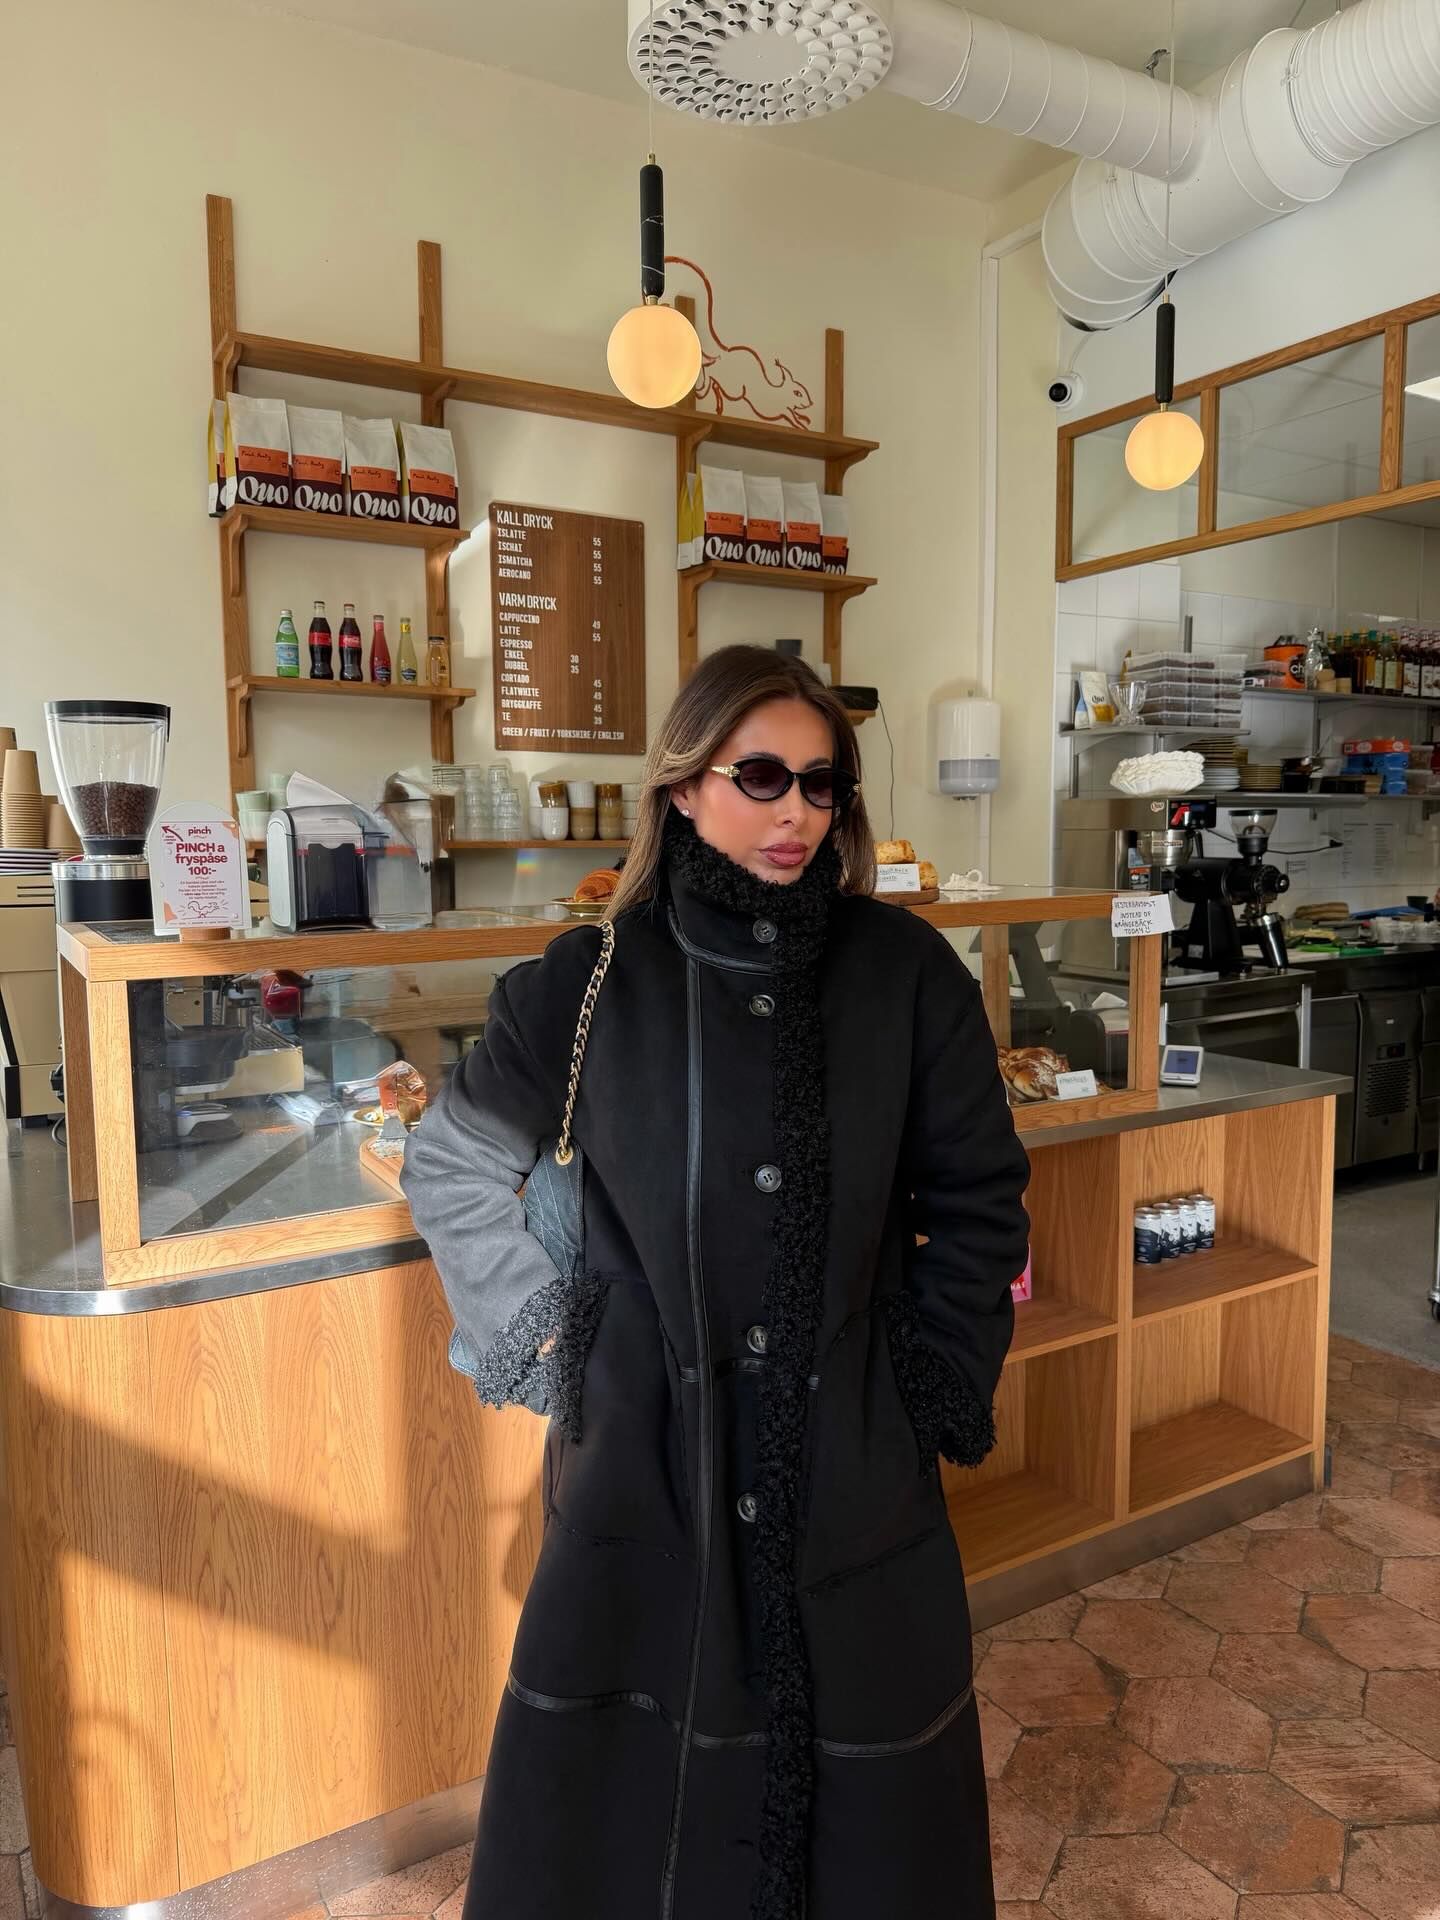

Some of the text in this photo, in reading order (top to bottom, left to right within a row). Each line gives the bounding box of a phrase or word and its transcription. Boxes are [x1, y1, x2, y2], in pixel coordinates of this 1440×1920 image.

[239, 475, 289, 506] Quo
[294, 484, 343, 513] Quo
[353, 491, 401, 520] Quo
[411, 496, 457, 525] Quo
[496, 510, 553, 530] KALL DRYCK
[497, 528, 602, 546] ISLATTE 55
[498, 541, 602, 560] ISCHAI 55
[705, 536, 744, 561] Quo
[745, 543, 781, 567] Quo
[498, 555, 602, 572] ISMATCHA 55
[787, 546, 821, 570] Quo
[498, 568, 602, 585] AEROCANO 55
[499, 592, 557, 611] VARM DRYCK
[499, 612, 601, 630] CAPPUCCINO 49
[500, 625, 601, 642] LATTE 55
[500, 638, 533, 650] ESPRESSO
[504, 650, 579, 664] ENKEL 30
[570, 665, 579, 674] 35
[501, 673, 602, 688] CORTADO 45
[501, 686, 540, 697] FLATWHITE
[501, 699, 602, 713] BRYGGKAFFE 45
[502, 712, 511, 721] TE
[502, 727, 523, 737] GREEN
[529, 728, 550, 738] FRUIT
[188, 826, 212, 837] pinch
[176, 843, 225, 853] PINCH a
[175, 852, 228, 866] fryspåse
[188, 866, 217, 876] 100:-
